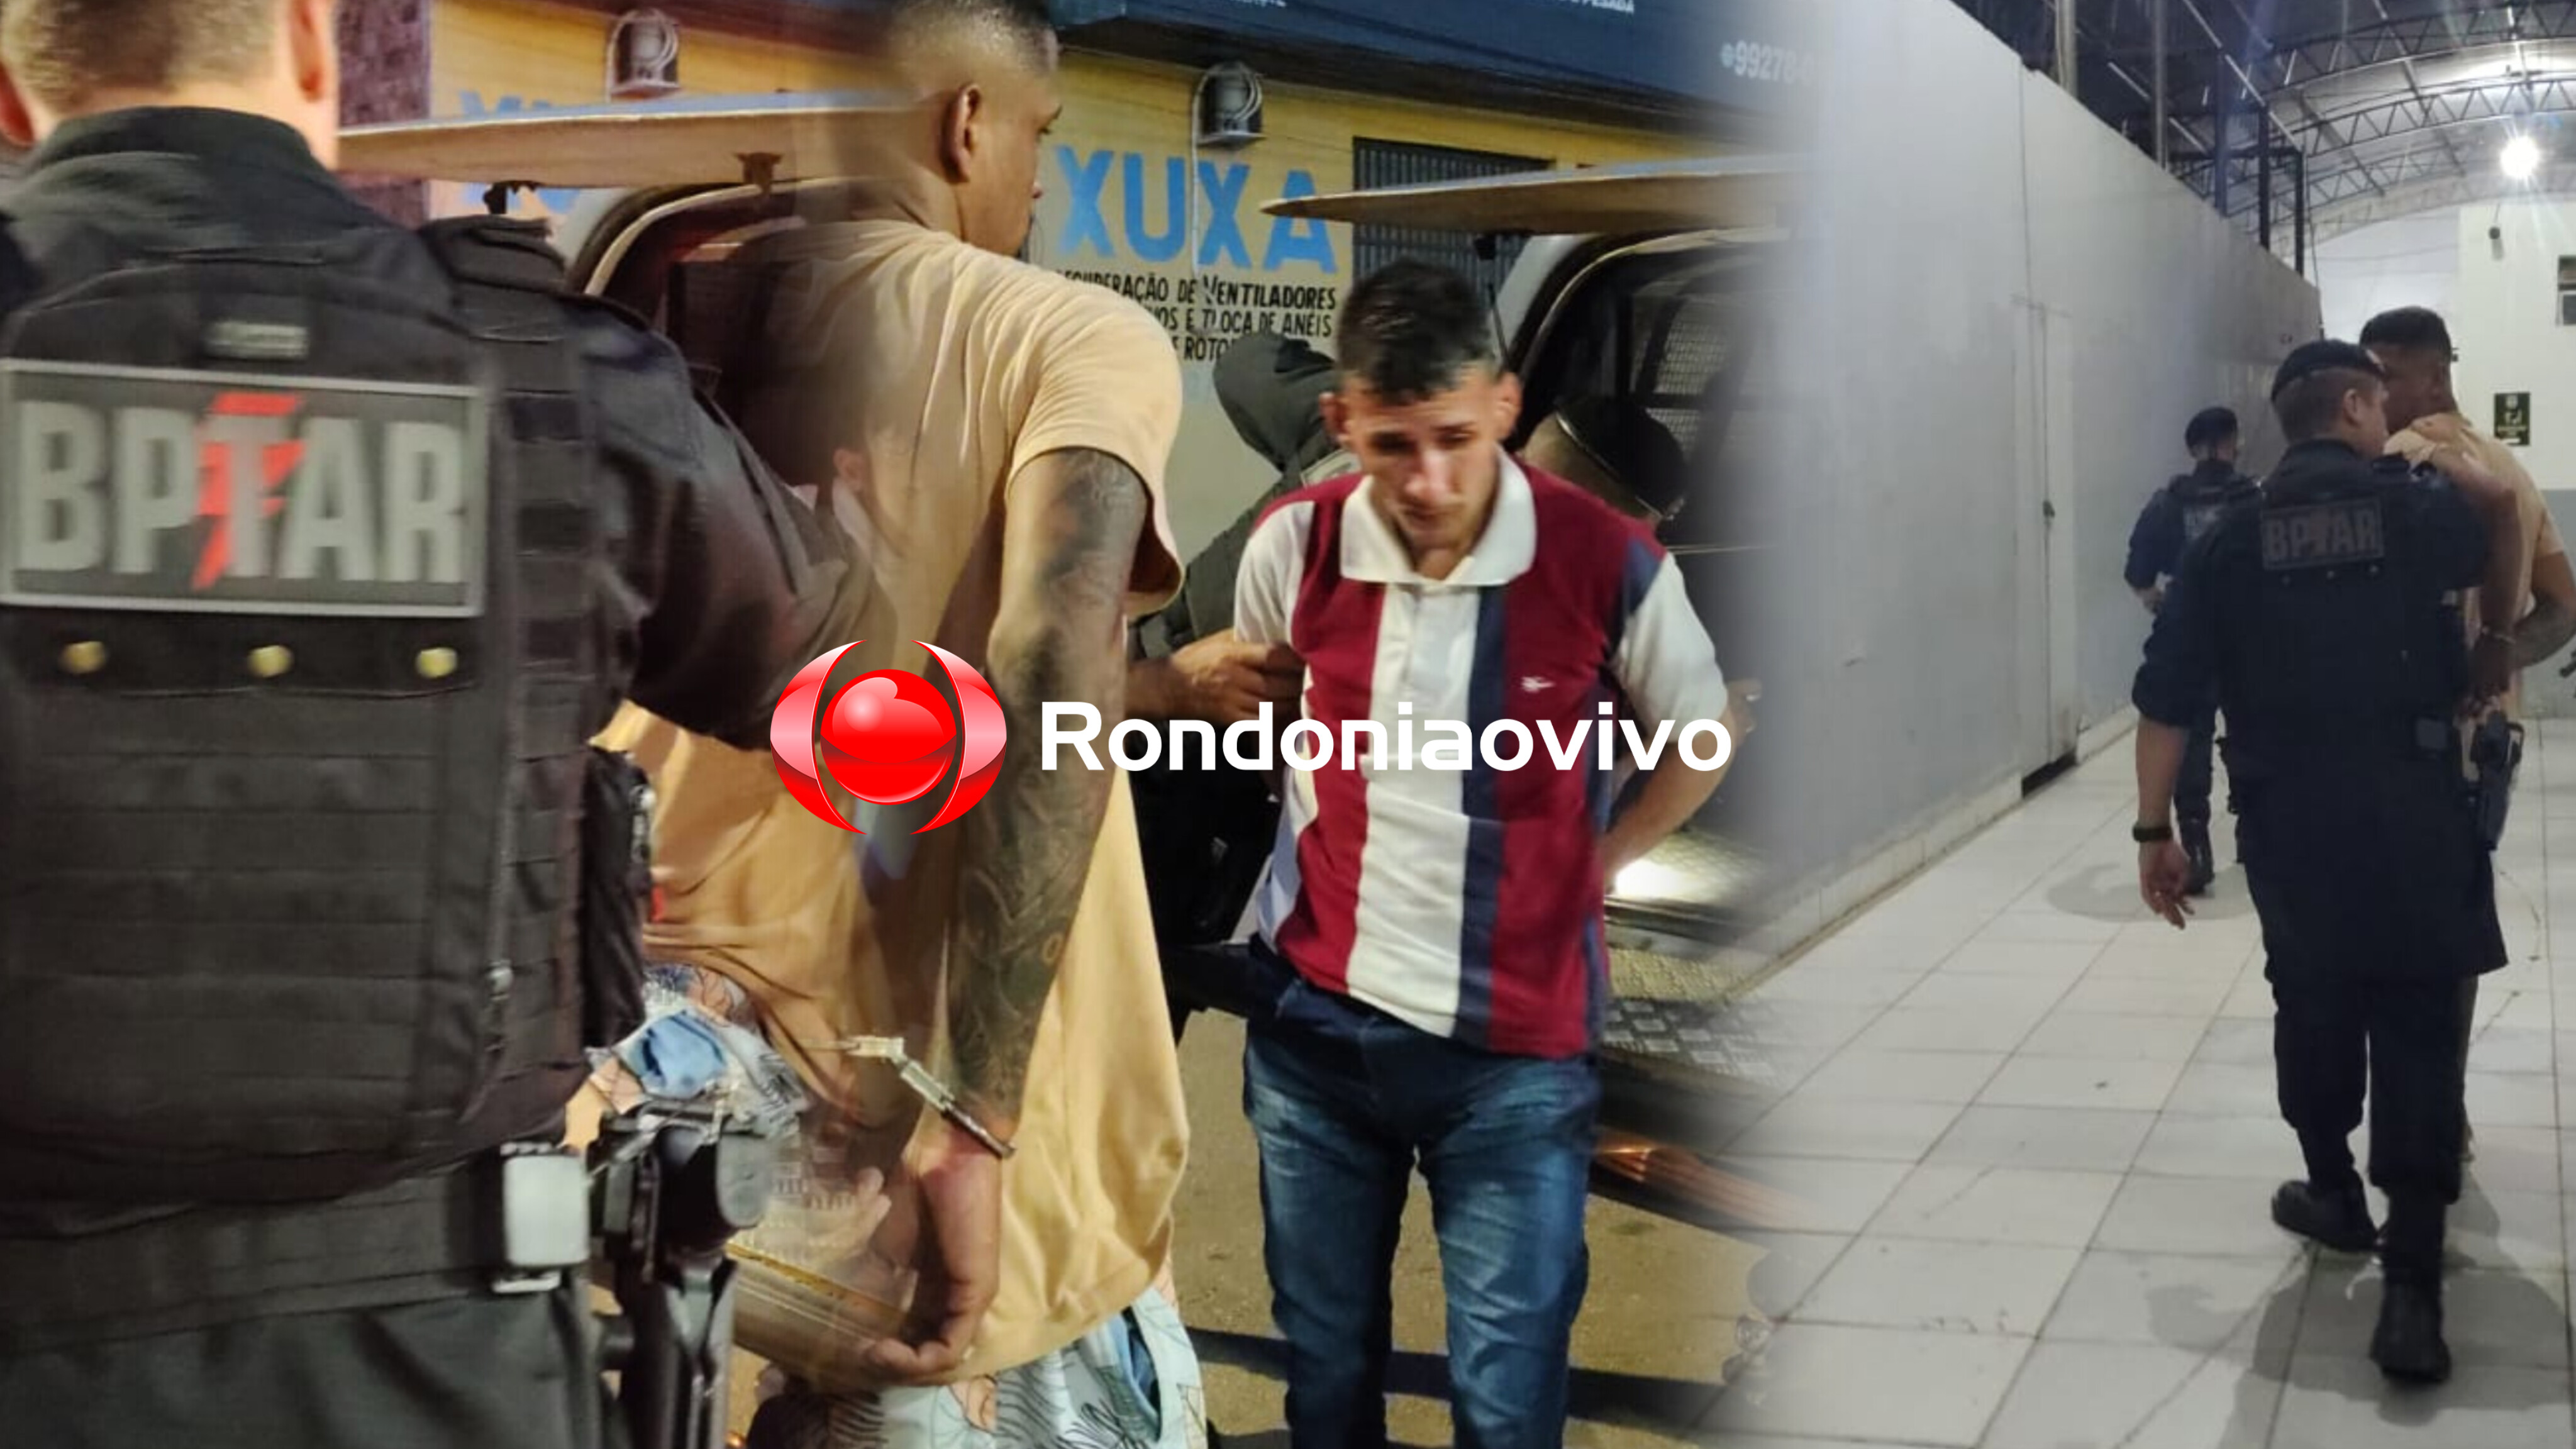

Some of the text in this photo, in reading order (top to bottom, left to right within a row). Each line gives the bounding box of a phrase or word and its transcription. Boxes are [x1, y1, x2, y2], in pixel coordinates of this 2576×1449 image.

[1054, 144, 1337, 274] XUXA
[1178, 279, 1197, 304] DE
[1202, 274, 1336, 309] VENTILADORES
[1185, 308, 1194, 333] E
[19, 393, 463, 586] BPTAR
